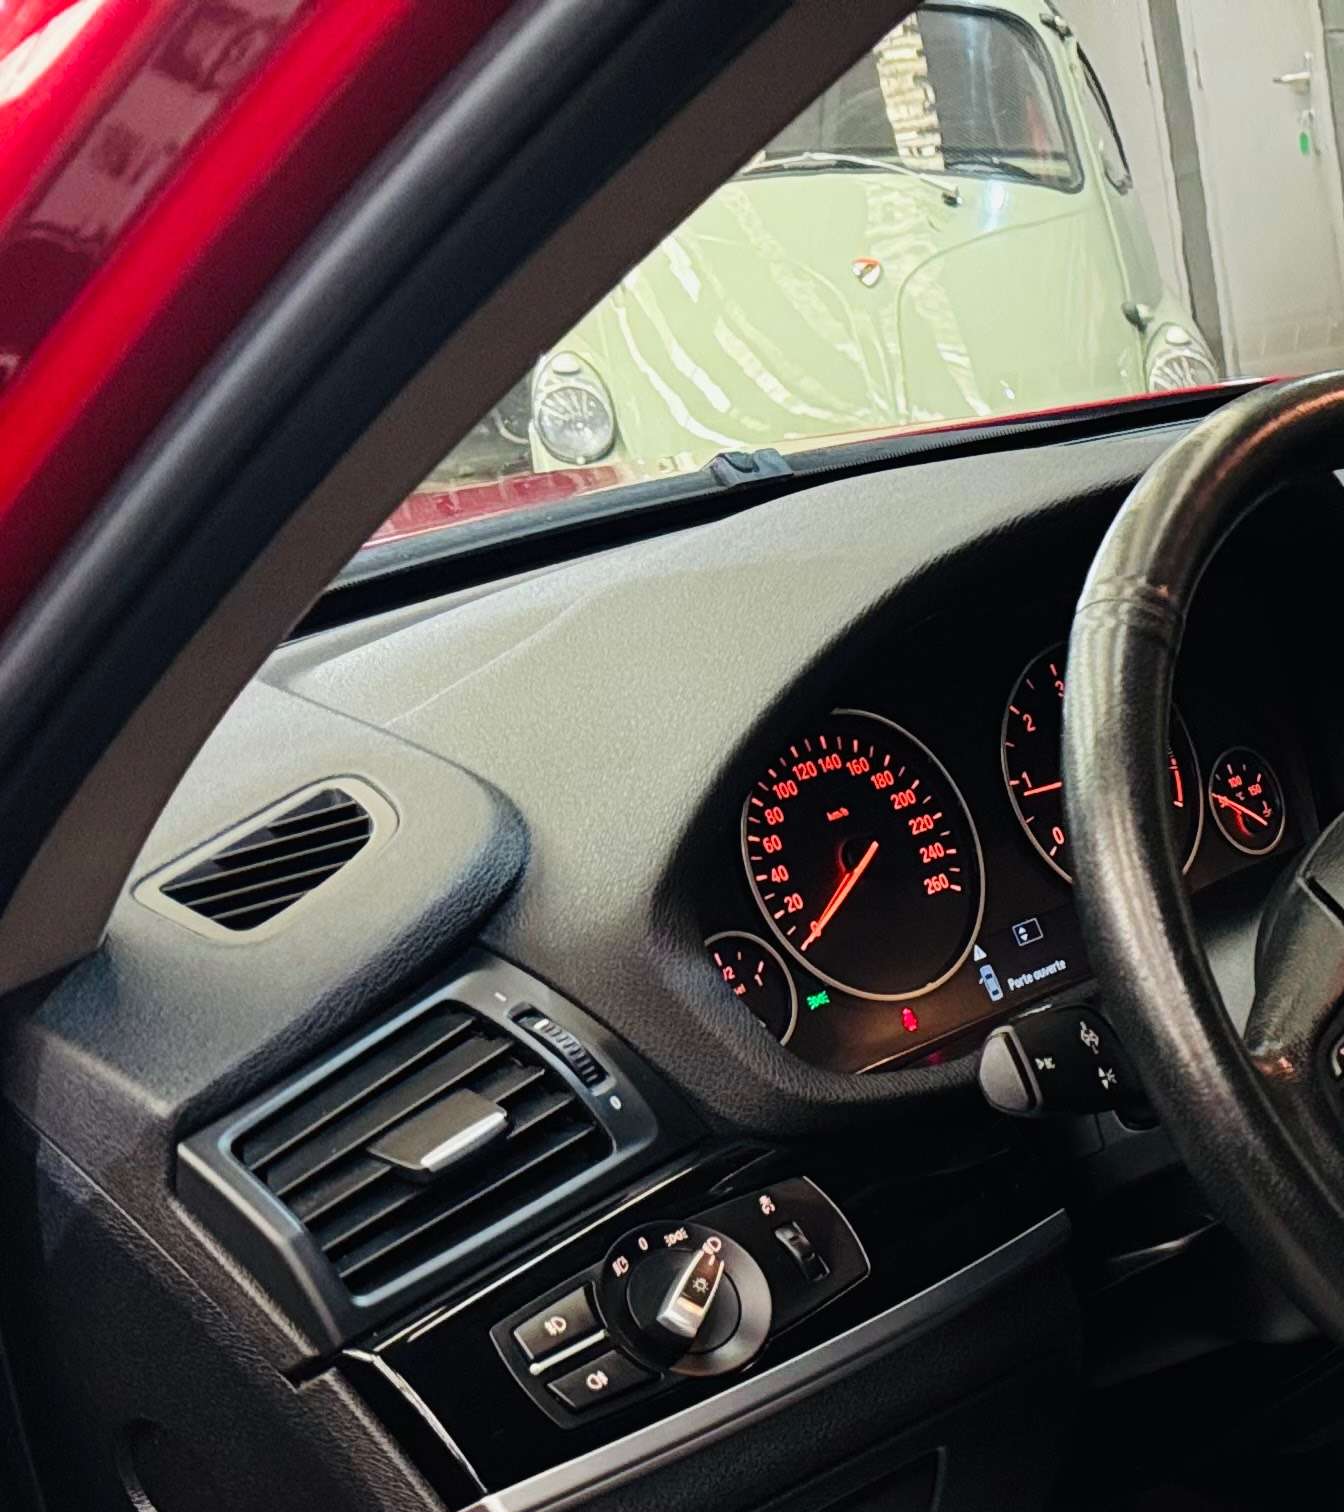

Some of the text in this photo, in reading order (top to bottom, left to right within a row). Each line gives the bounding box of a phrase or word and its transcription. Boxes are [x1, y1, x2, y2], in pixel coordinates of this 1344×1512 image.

[792, 761, 817, 781] 120
[818, 753, 842, 773] 140
[846, 757, 870, 776] 160
[772, 779, 798, 800] 100
[870, 770, 894, 789] 180
[890, 789, 916, 810] 200
[764, 806, 785, 825] 80
[908, 814, 934, 835] 220
[762, 834, 782, 853] 60
[919, 842, 945, 863] 240
[771, 865, 789, 883] 40
[923, 873, 949, 895] 260
[784, 893, 803, 913] 20
[1033, 959, 1067, 981] ouverte
